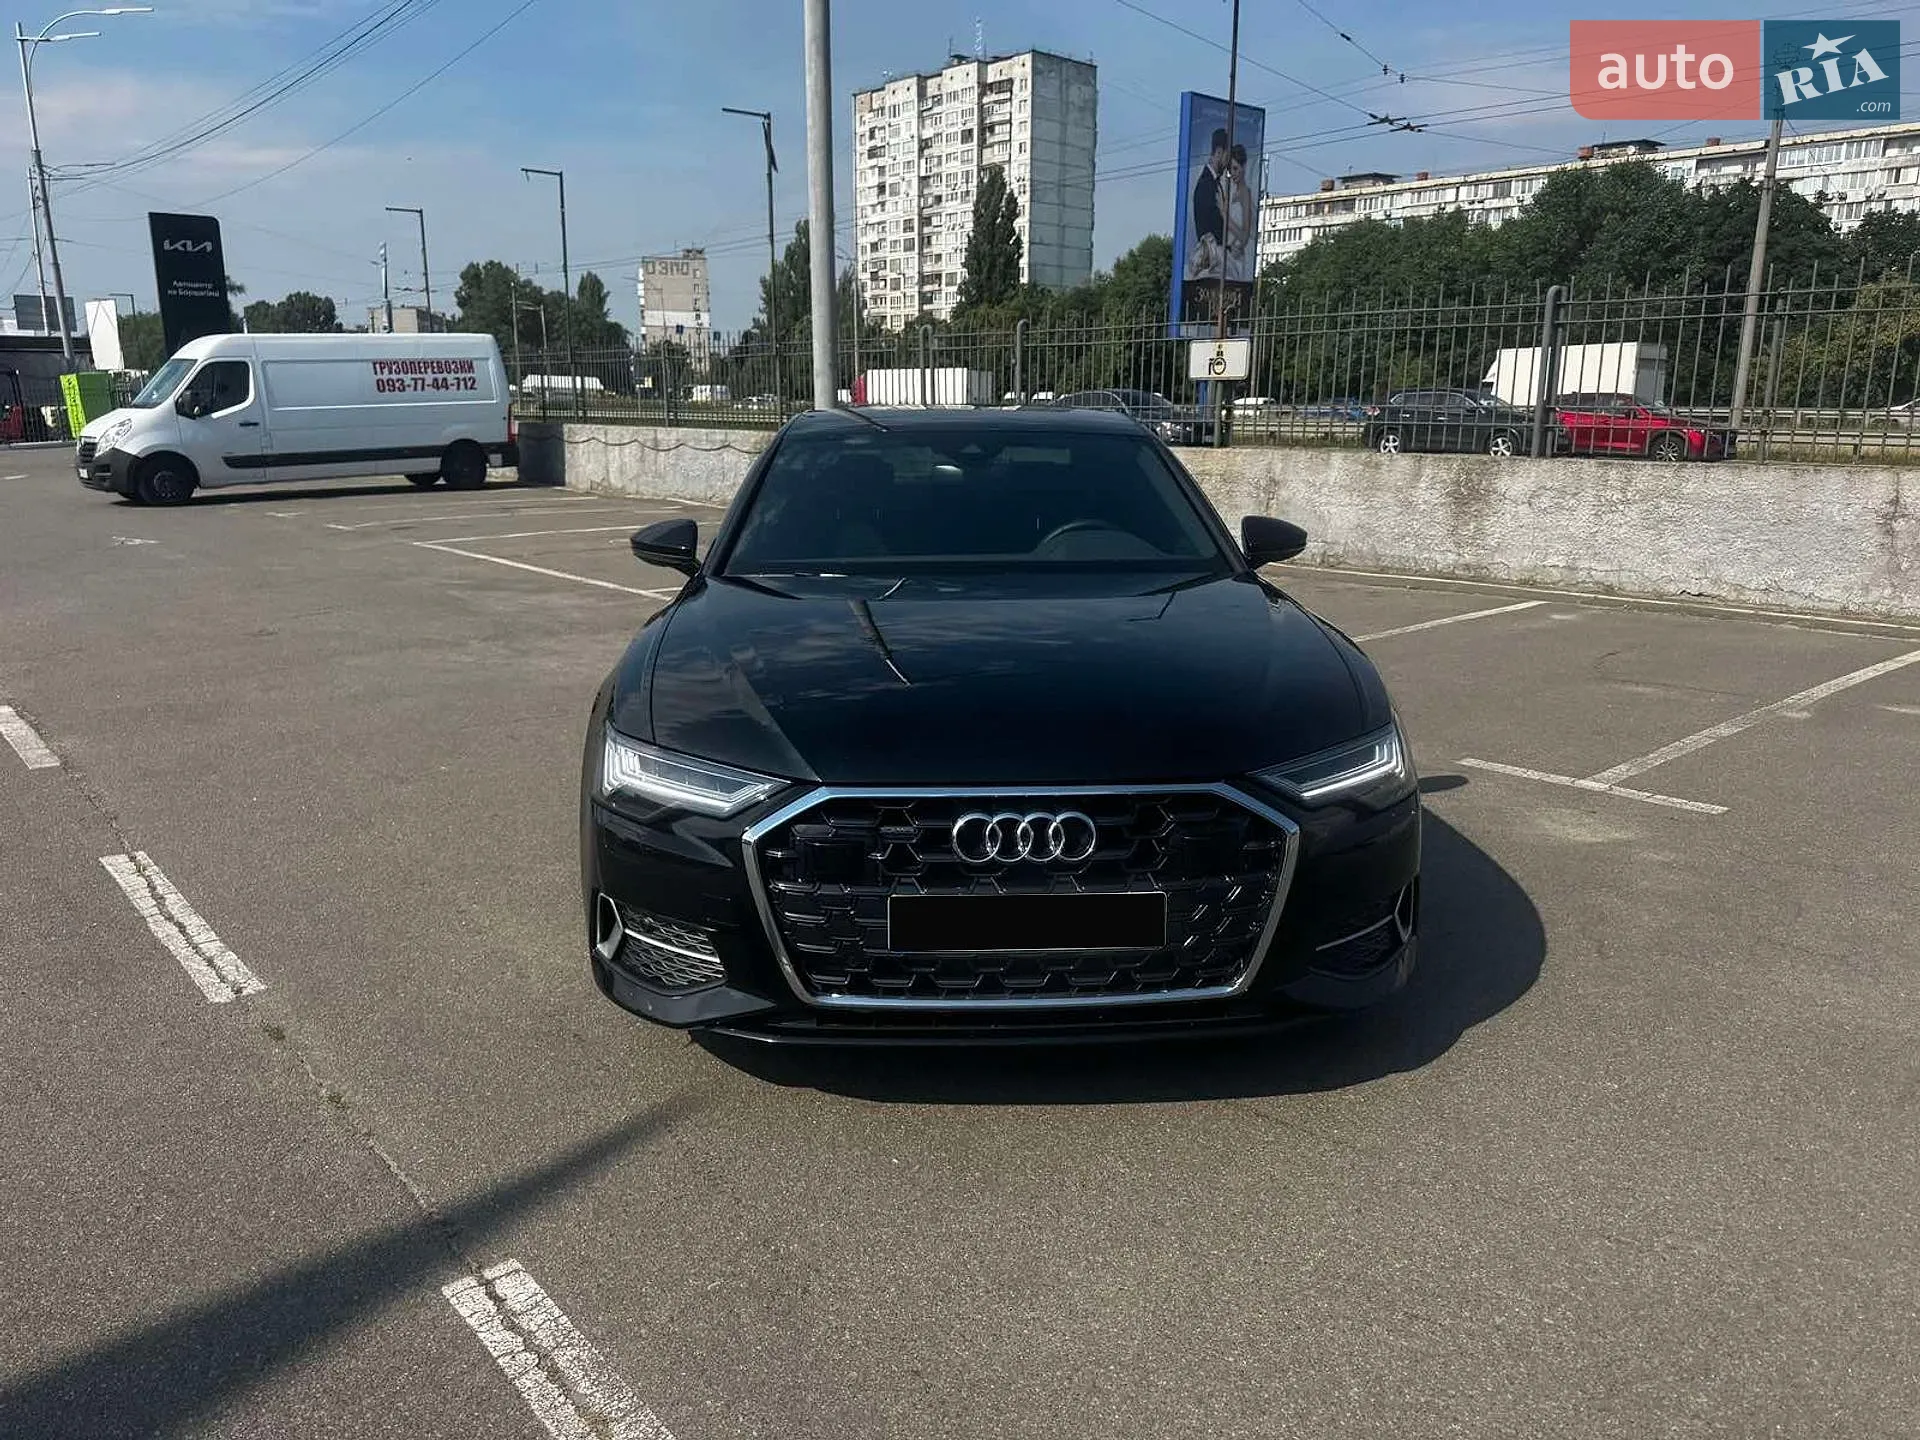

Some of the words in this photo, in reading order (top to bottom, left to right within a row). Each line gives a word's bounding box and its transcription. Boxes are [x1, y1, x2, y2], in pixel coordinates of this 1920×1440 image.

[163, 239, 213, 253] KIA
[372, 359, 476, 376] ГРУЗОПЕРЕВОЗКИ
[376, 376, 478, 393] 093-77-44-712
